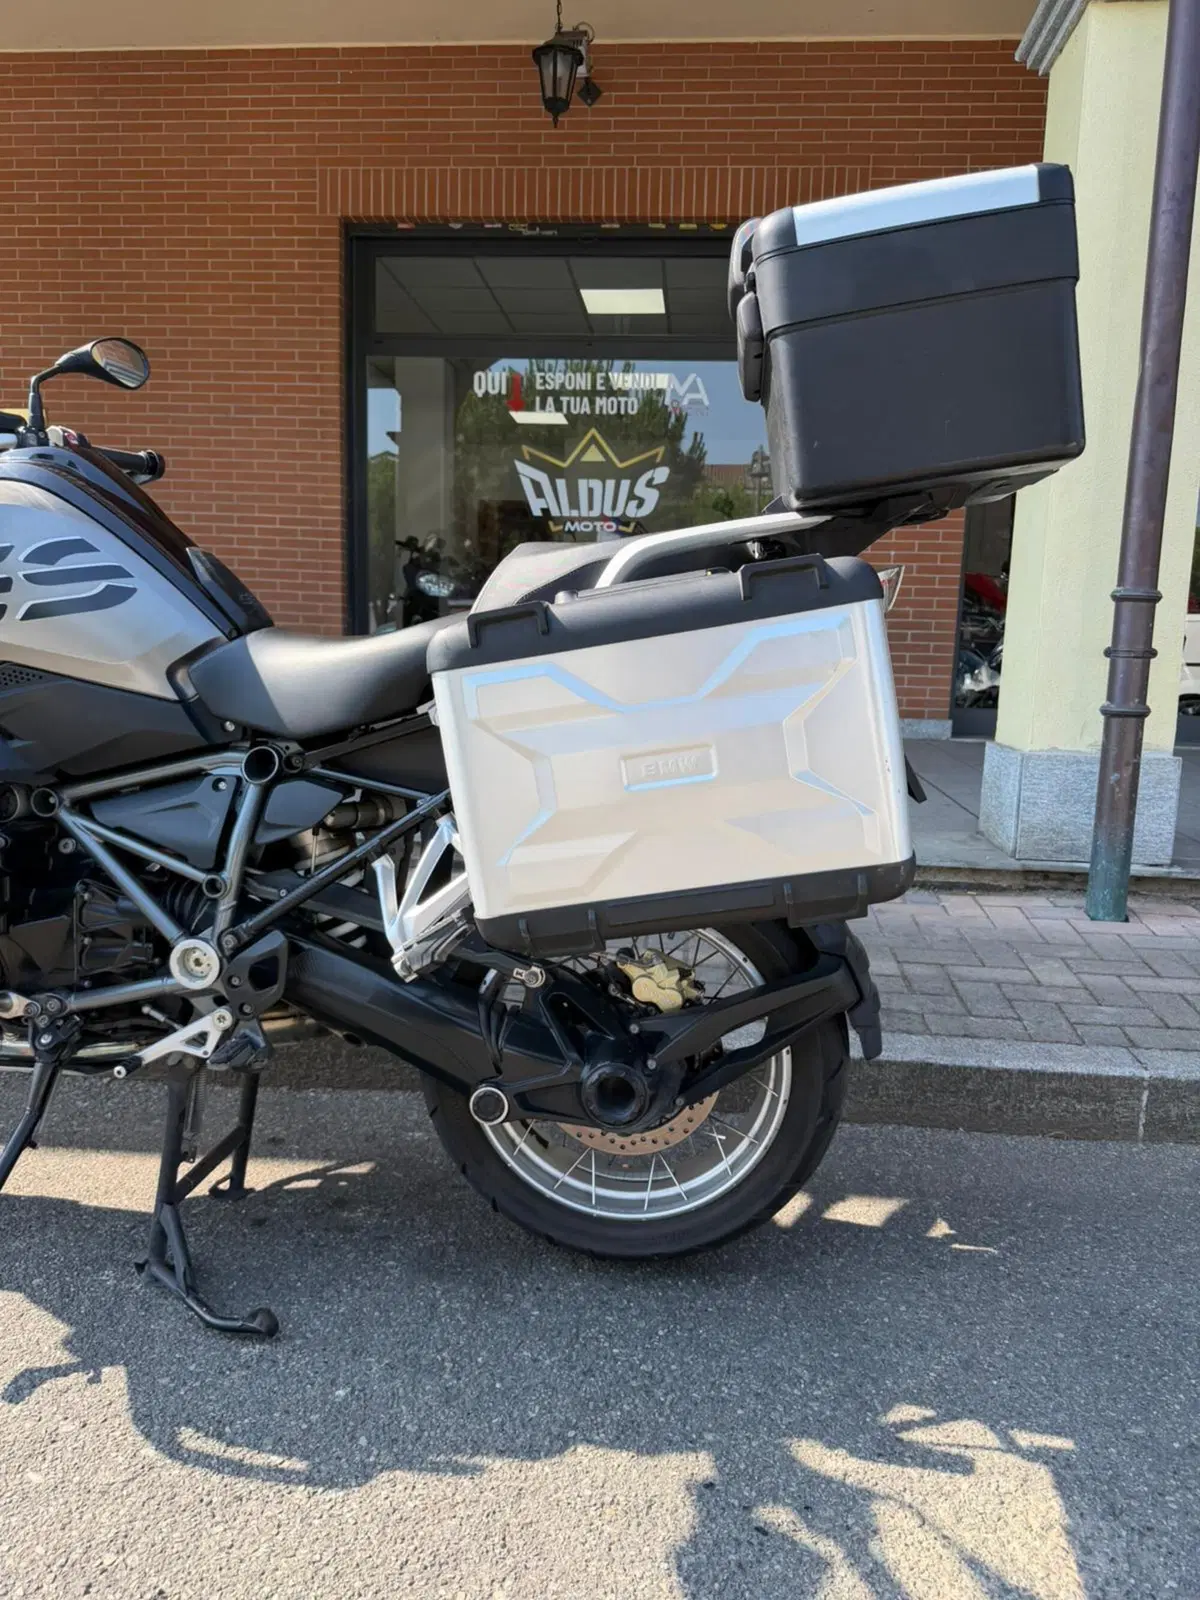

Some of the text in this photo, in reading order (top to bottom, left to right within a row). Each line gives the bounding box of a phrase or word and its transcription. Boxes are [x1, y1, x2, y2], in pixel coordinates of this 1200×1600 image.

[473, 371, 507, 398] QUI
[535, 372, 592, 391] ESPONI
[596, 372, 606, 391] E
[535, 396, 639, 415] LA TUA MOTO
[513, 459, 671, 518] ALDUS
[564, 520, 617, 533] MOTO
